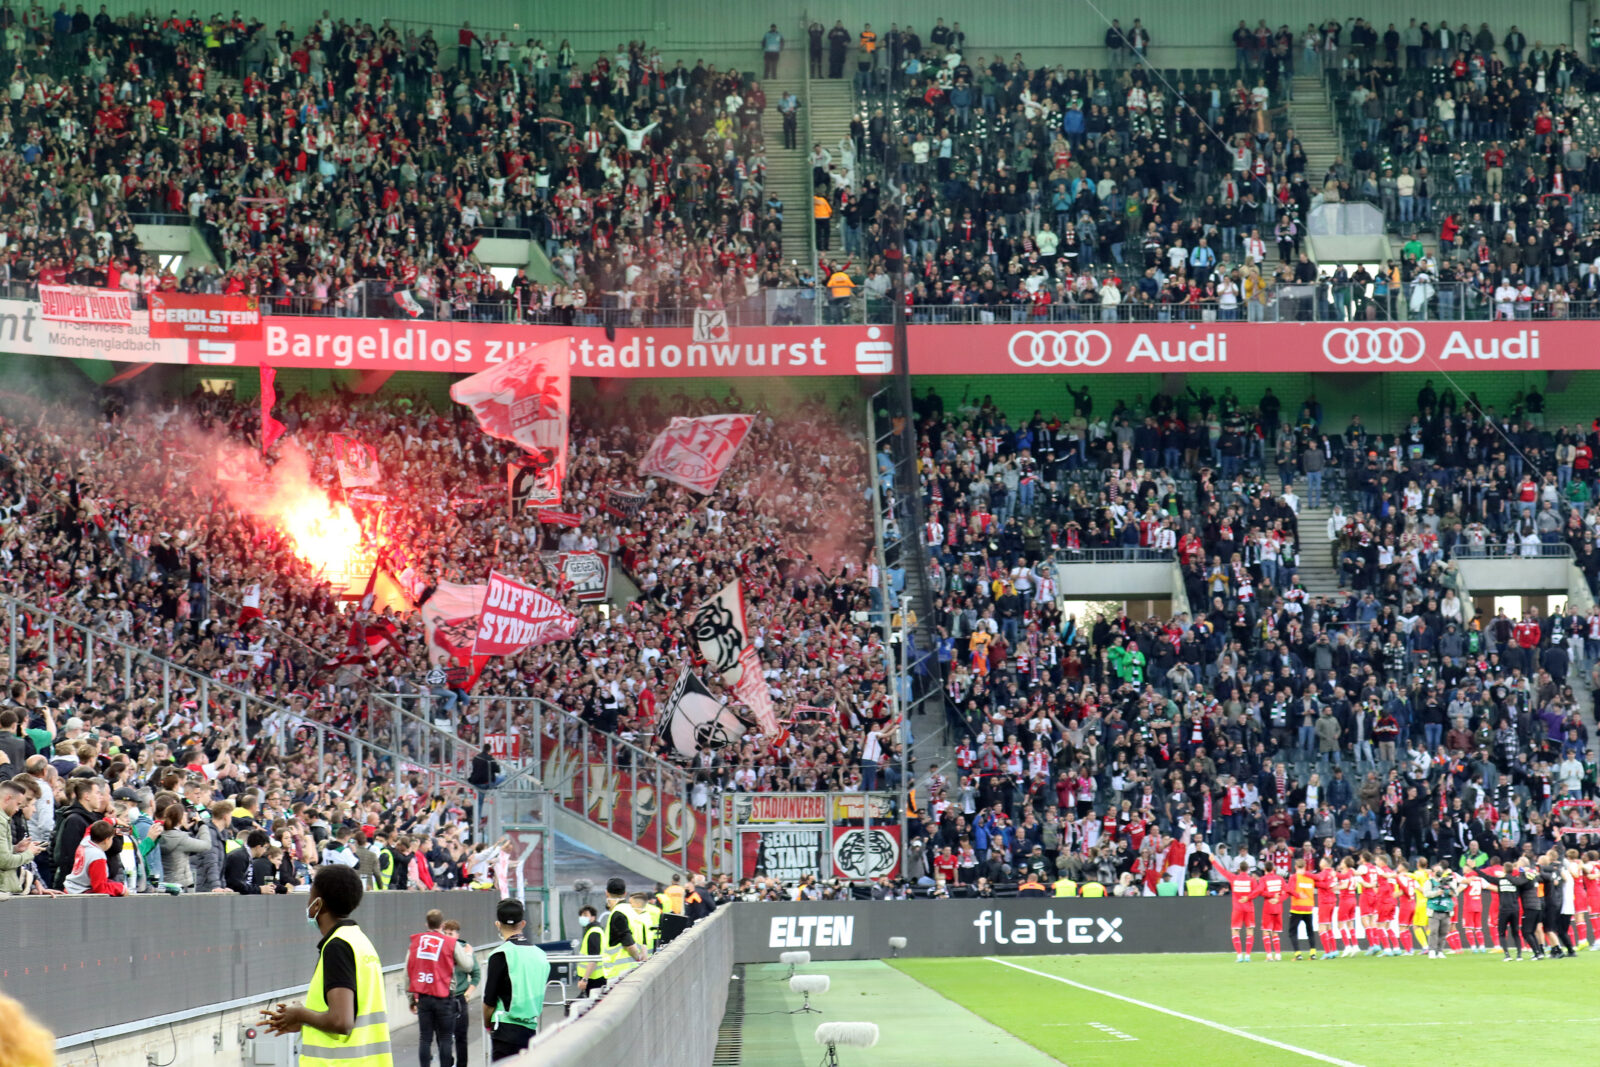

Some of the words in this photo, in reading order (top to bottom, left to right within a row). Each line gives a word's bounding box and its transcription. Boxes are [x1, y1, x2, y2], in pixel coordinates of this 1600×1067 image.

[152, 308, 258, 325] GEROLSTEIN
[48, 332, 160, 352] Mönchengladbach
[266, 326, 472, 366] Bargeldlos
[1125, 333, 1227, 362] Audi
[1440, 330, 1540, 359] Audi
[764, 846, 819, 869] STADT
[768, 915, 854, 948] ELTEN
[417, 971, 435, 984] 36
